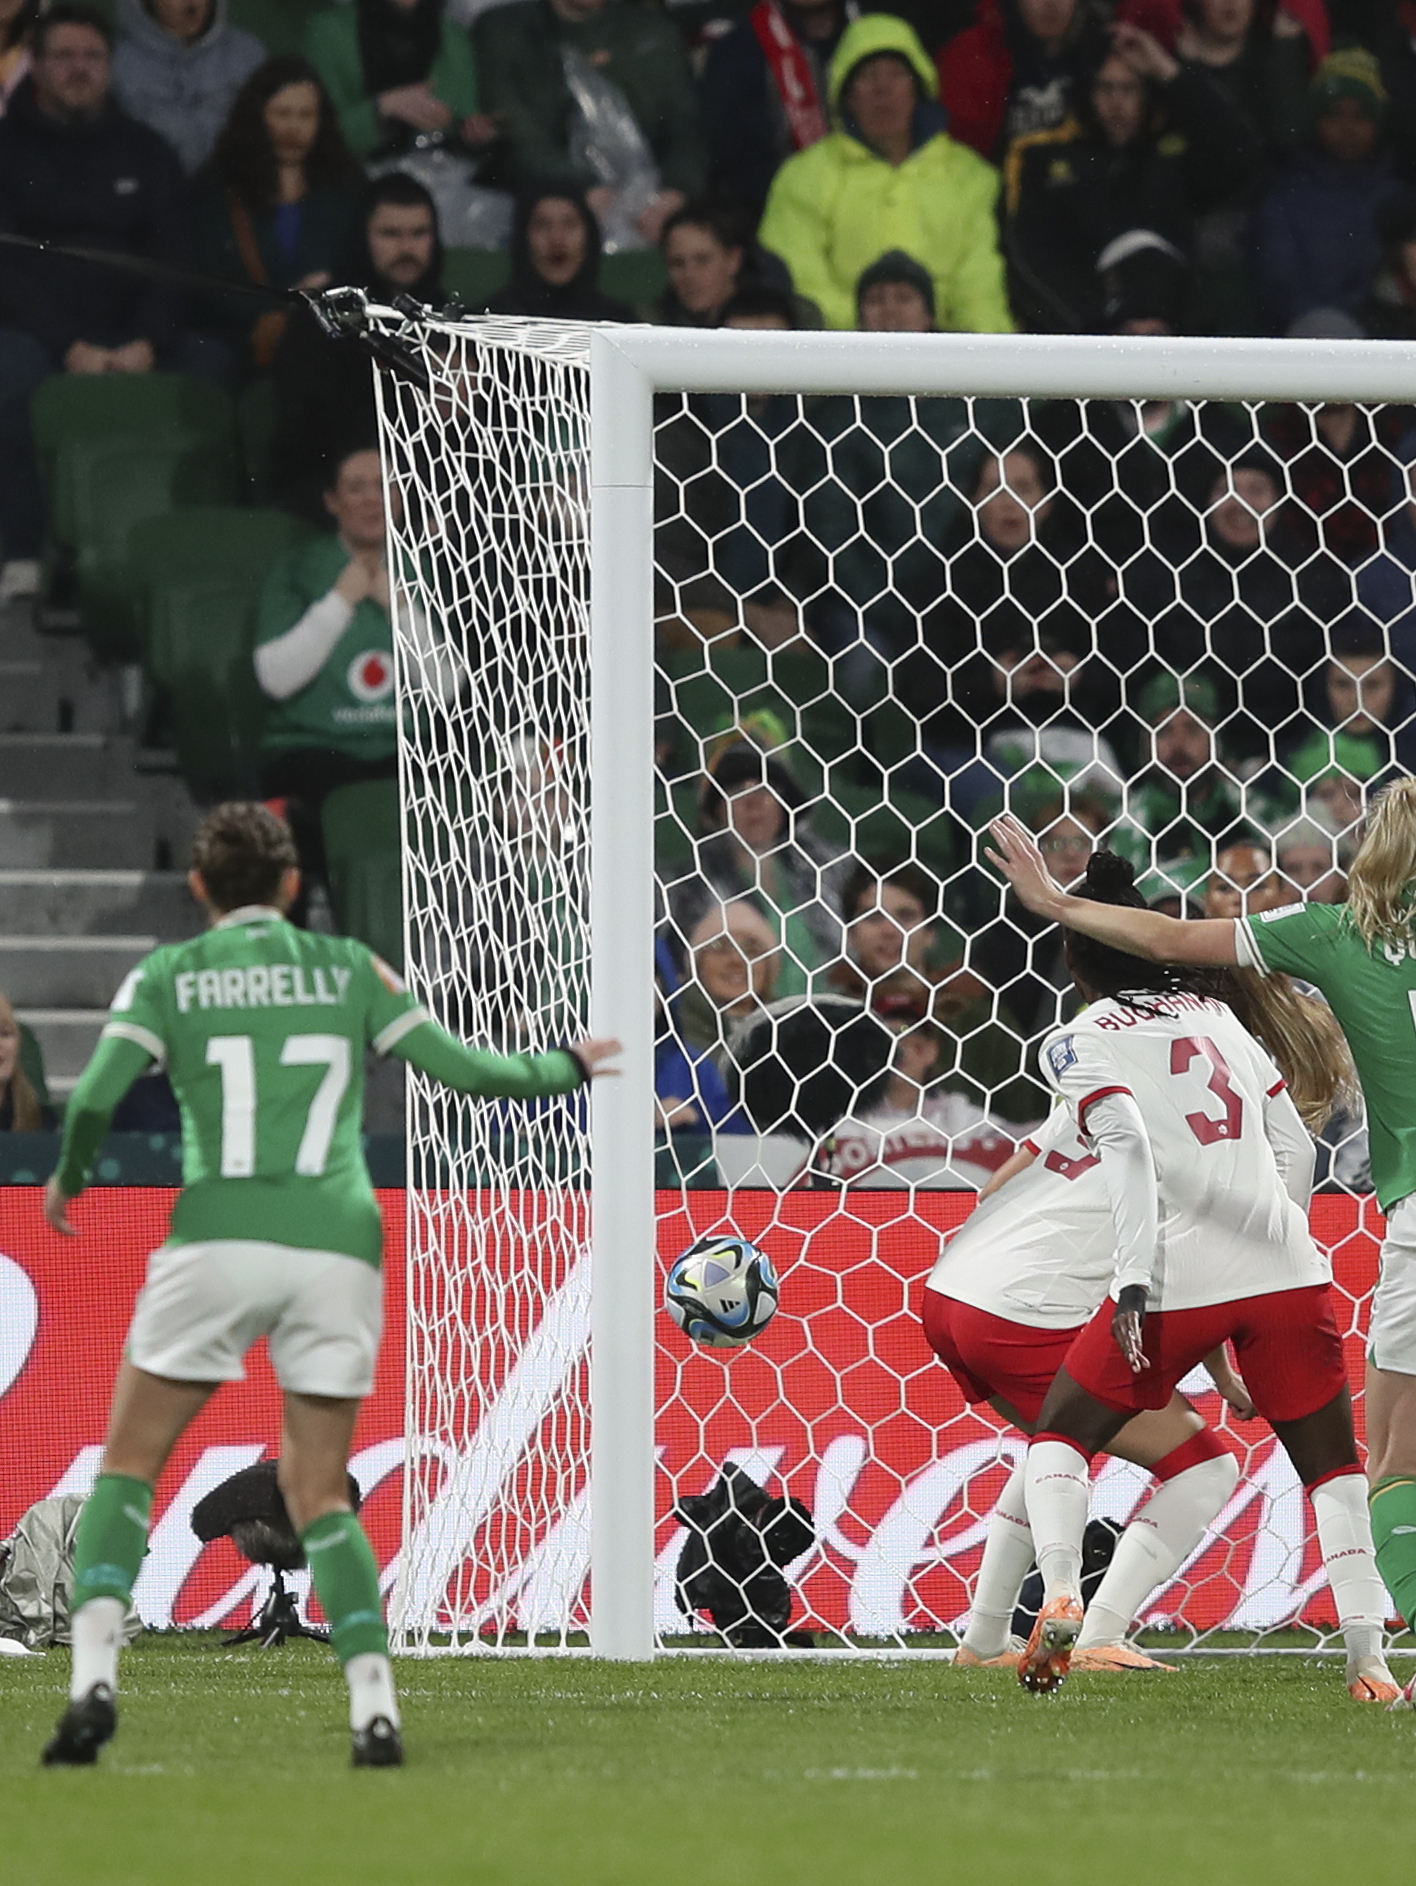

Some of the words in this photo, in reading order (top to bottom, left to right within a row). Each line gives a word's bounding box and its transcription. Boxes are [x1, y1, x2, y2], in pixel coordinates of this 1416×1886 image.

[175, 963, 351, 1014] FARRELLY
[205, 1033, 352, 1179] 17
[1170, 1035, 1243, 1147] 3
[1326, 1547, 1367, 1563] ANADA
